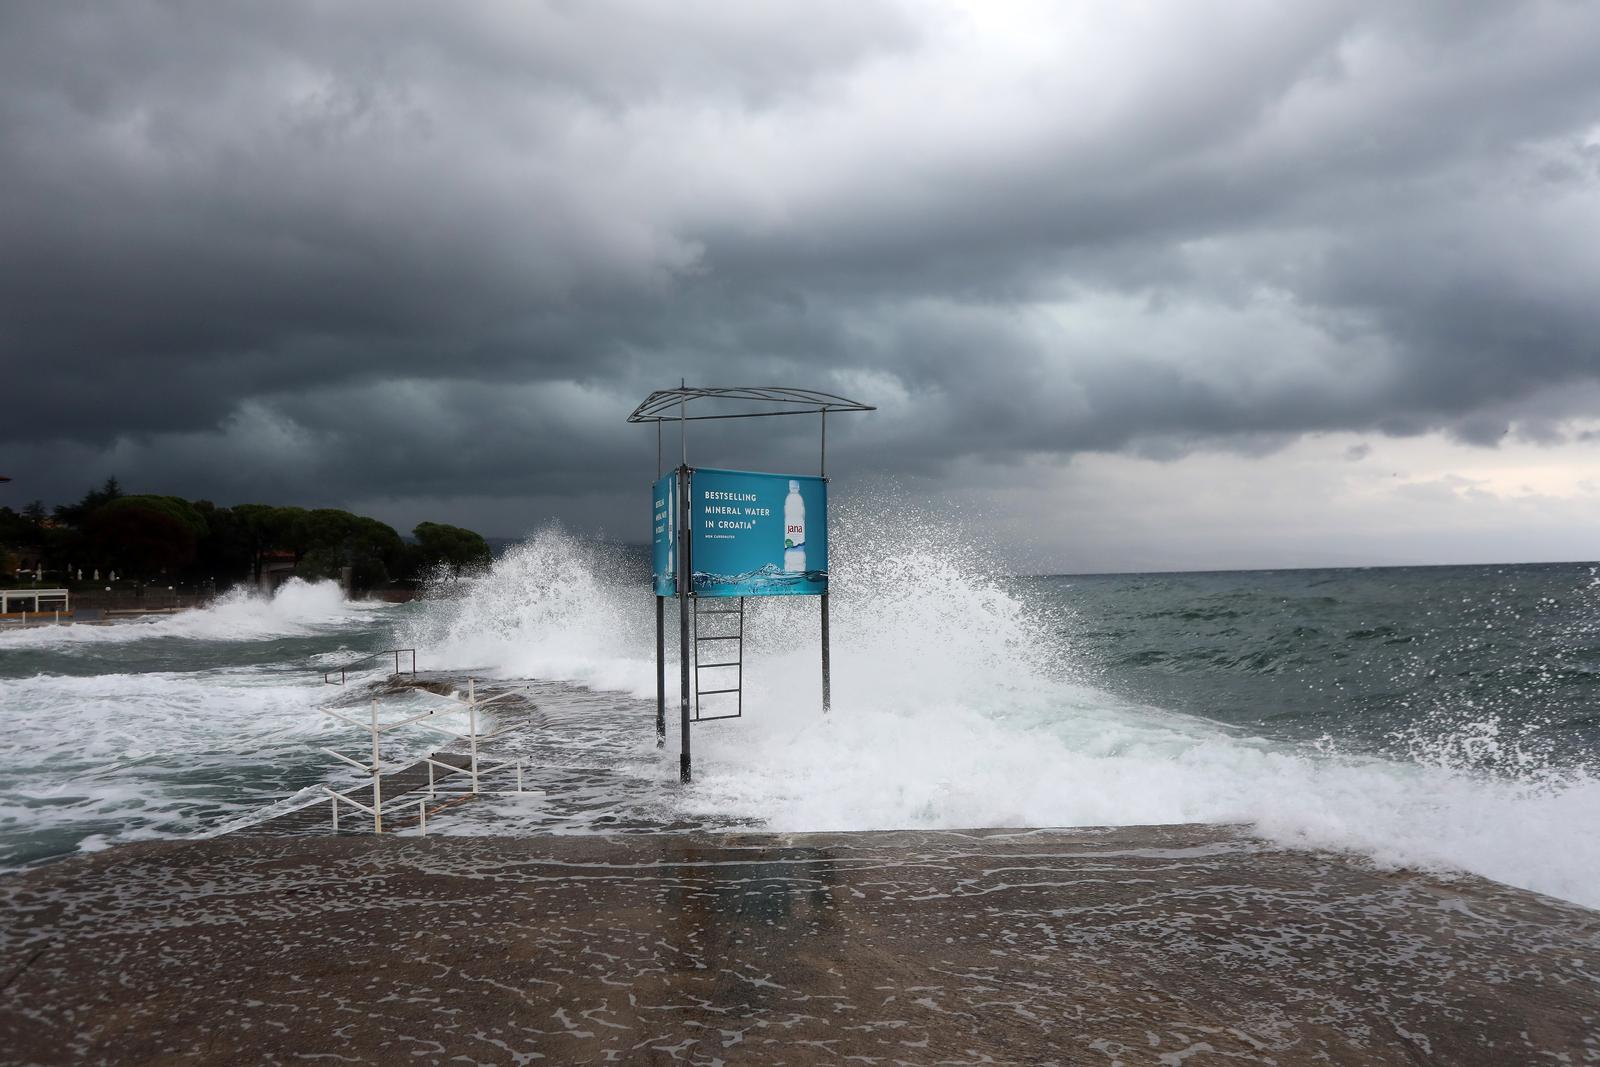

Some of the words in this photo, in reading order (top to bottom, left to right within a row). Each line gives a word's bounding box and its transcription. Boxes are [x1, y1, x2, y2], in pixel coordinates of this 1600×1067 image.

[705, 491, 757, 502] BESTSELLING
[705, 506, 742, 515] MINERAL
[745, 507, 770, 516] WATER
[705, 520, 714, 528] IN
